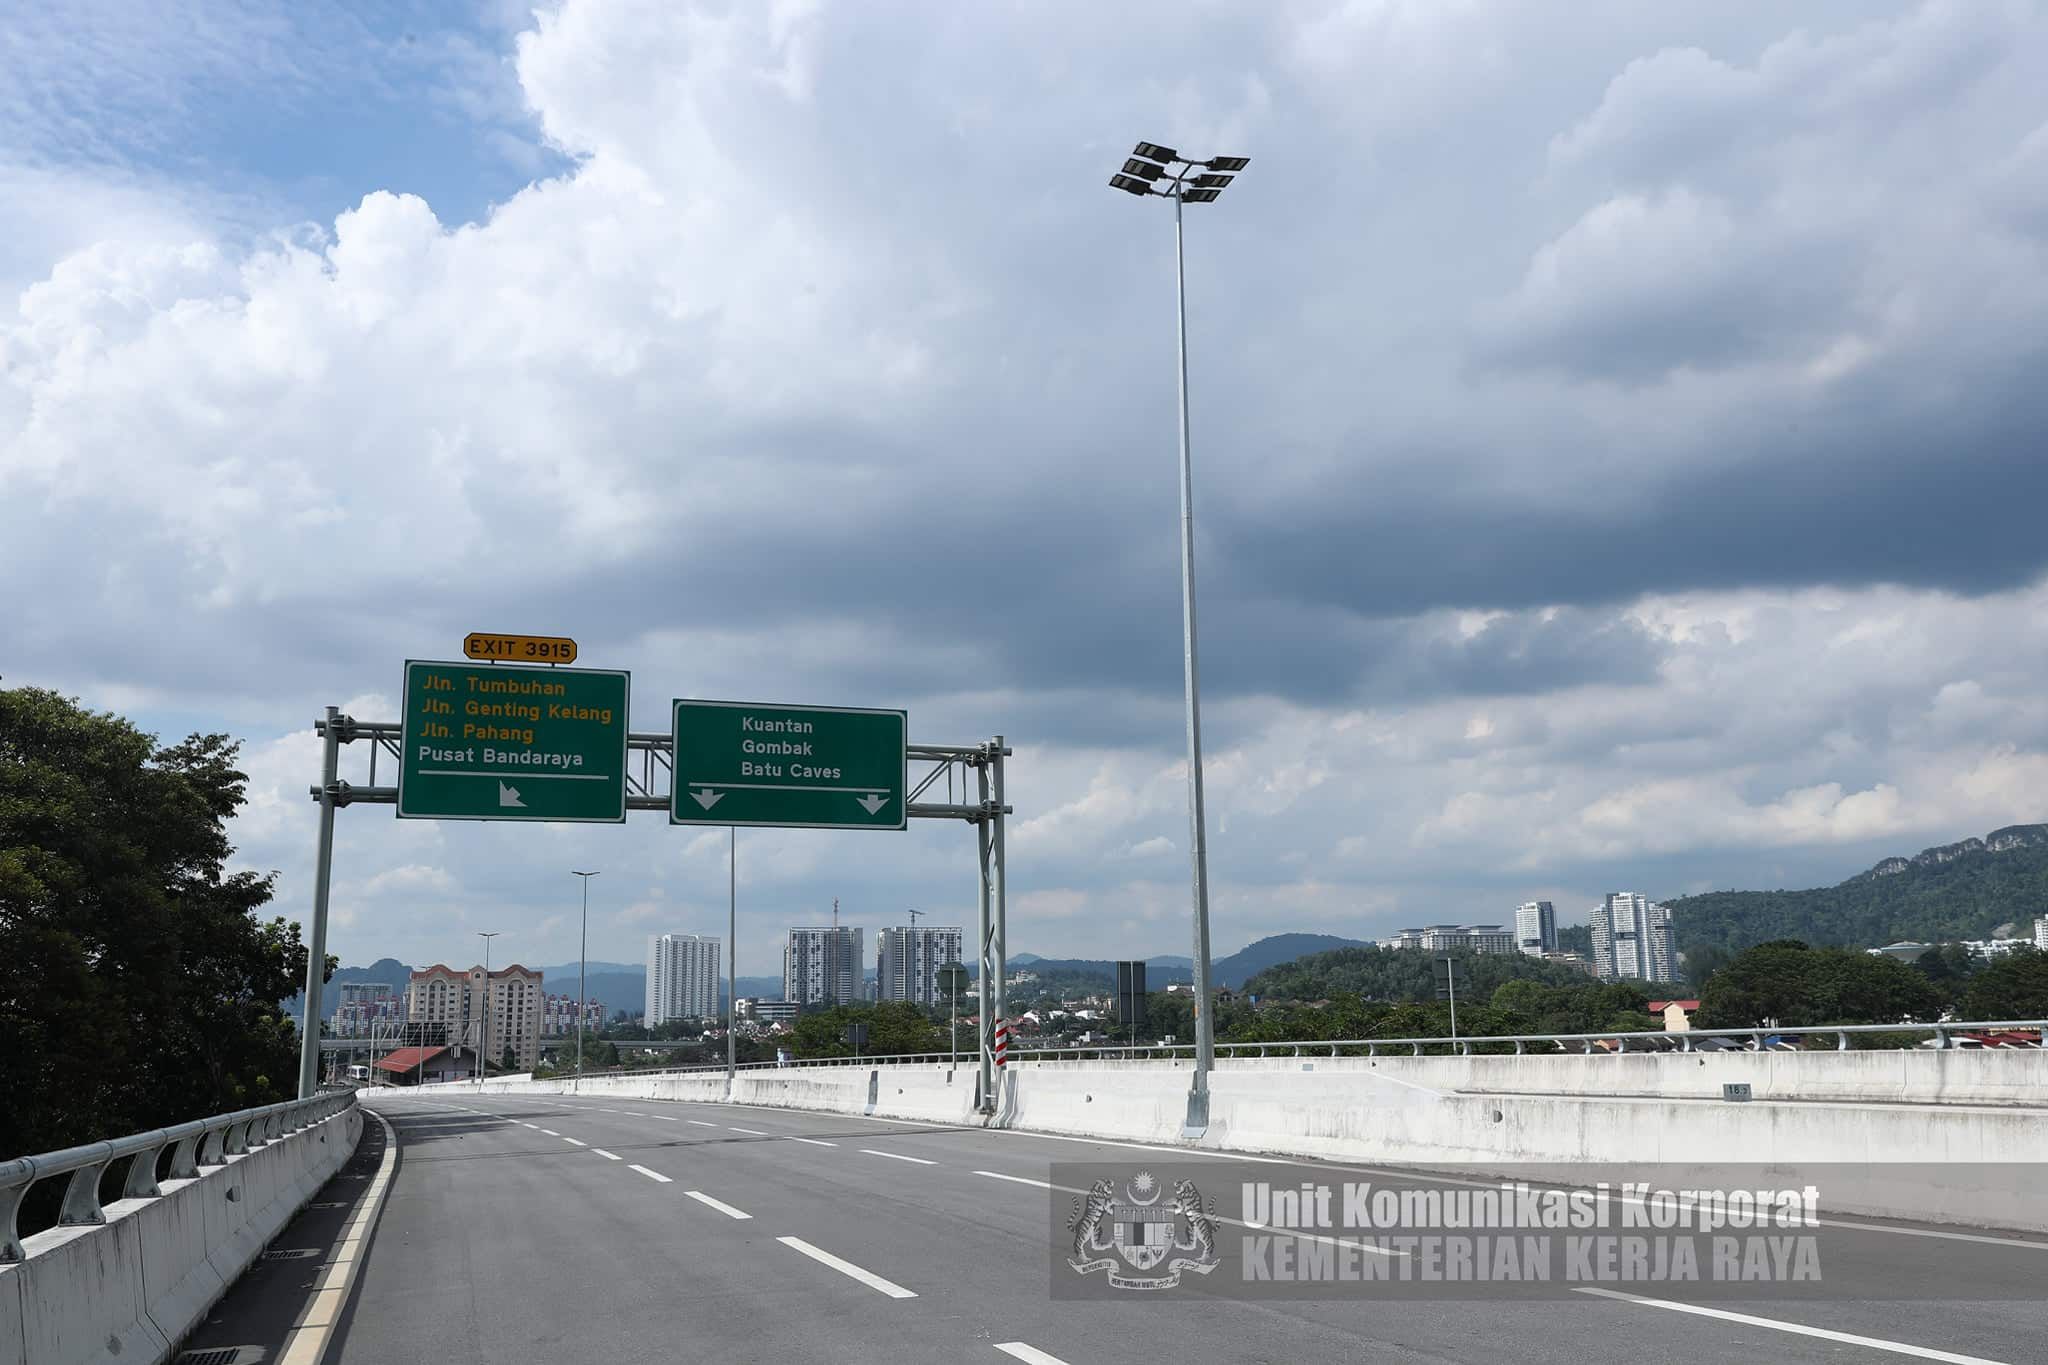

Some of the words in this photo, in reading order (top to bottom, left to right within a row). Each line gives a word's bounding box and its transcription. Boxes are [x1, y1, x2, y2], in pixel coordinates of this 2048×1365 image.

[470, 639, 516, 655] EXIT
[526, 642, 571, 658] 3915
[423, 675, 456, 691] Jln.
[467, 676, 566, 696] Tumbuhan
[422, 698, 455, 714] Jln.
[465, 700, 540, 721] Genting
[549, 704, 612, 725] Kelang
[420, 722, 453, 738] Jln.
[463, 724, 534, 744] Pahang
[742, 716, 813, 733] Kuantan
[418, 746, 474, 762] Pusat
[483, 748, 584, 769] Bandaraya
[742, 739, 813, 756] Gombak
[741, 761, 782, 777] Batu
[790, 763, 841, 778] Caves
